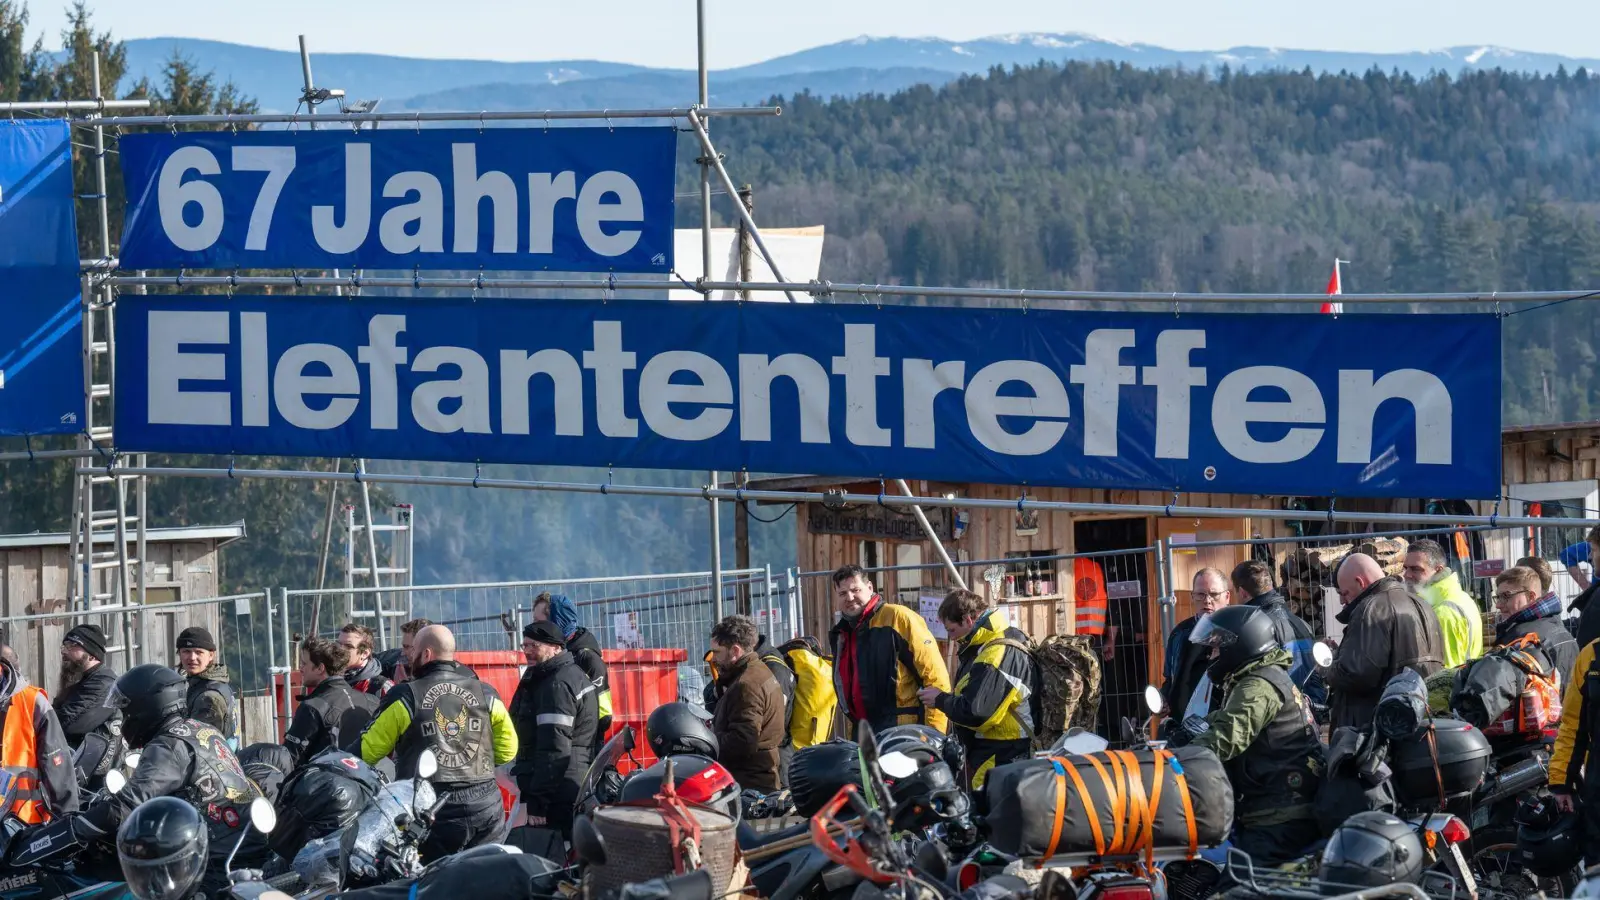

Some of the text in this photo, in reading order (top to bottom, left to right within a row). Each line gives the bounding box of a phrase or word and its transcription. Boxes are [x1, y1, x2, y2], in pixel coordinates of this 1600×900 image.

[158, 142, 645, 257] 67 Jahre
[148, 310, 1453, 465] Elefantentreffen
[423, 683, 478, 709] BOMBHOLDERS
[423, 722, 435, 735] M
[471, 720, 480, 731] C
